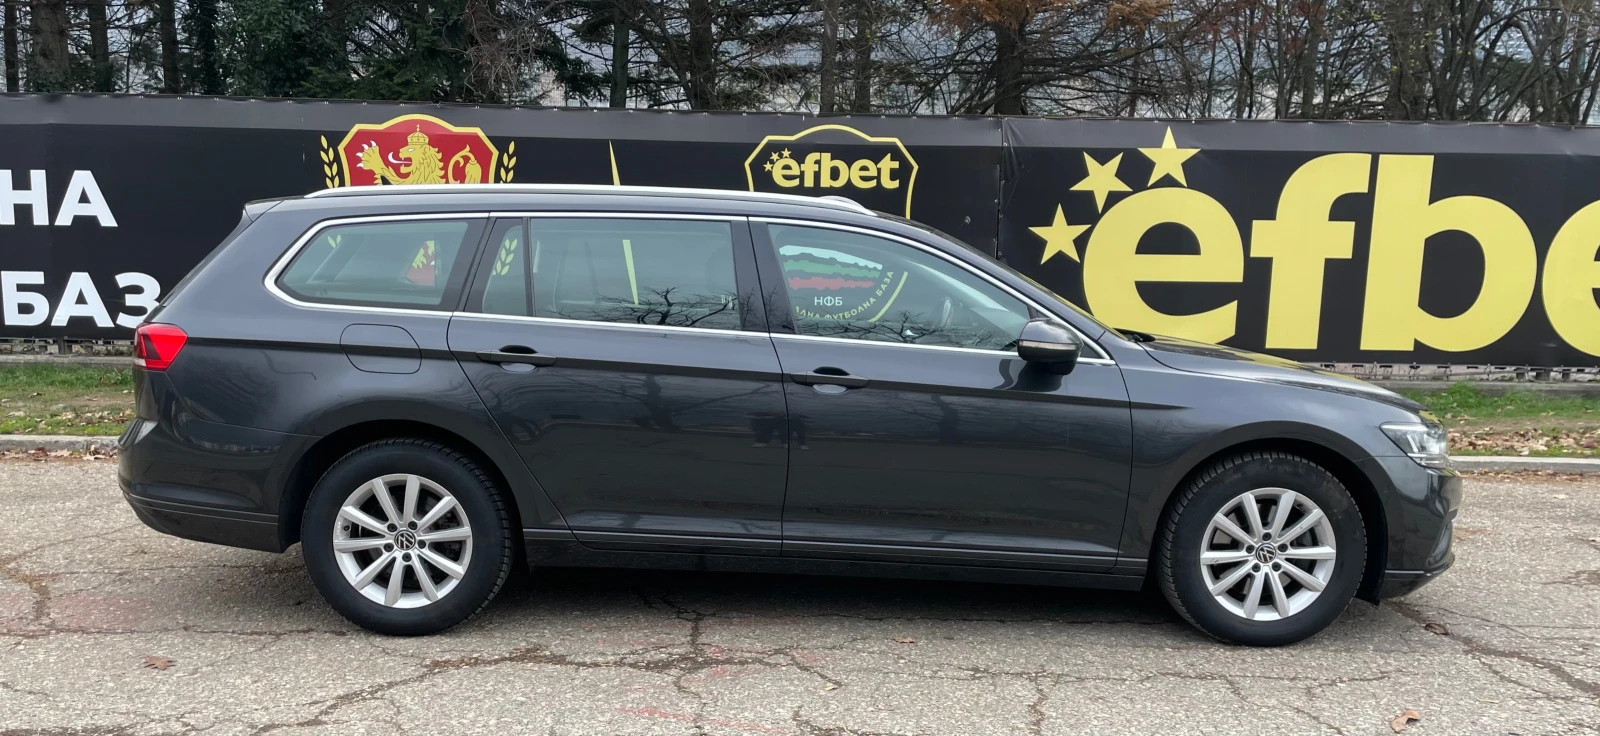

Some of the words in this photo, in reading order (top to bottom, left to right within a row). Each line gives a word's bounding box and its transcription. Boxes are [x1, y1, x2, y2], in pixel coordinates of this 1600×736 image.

[771, 152, 900, 189] efbet
[0, 169, 119, 227] НА
[875, 271, 894, 297] БАЗА
[814, 295, 843, 307] НФБ
